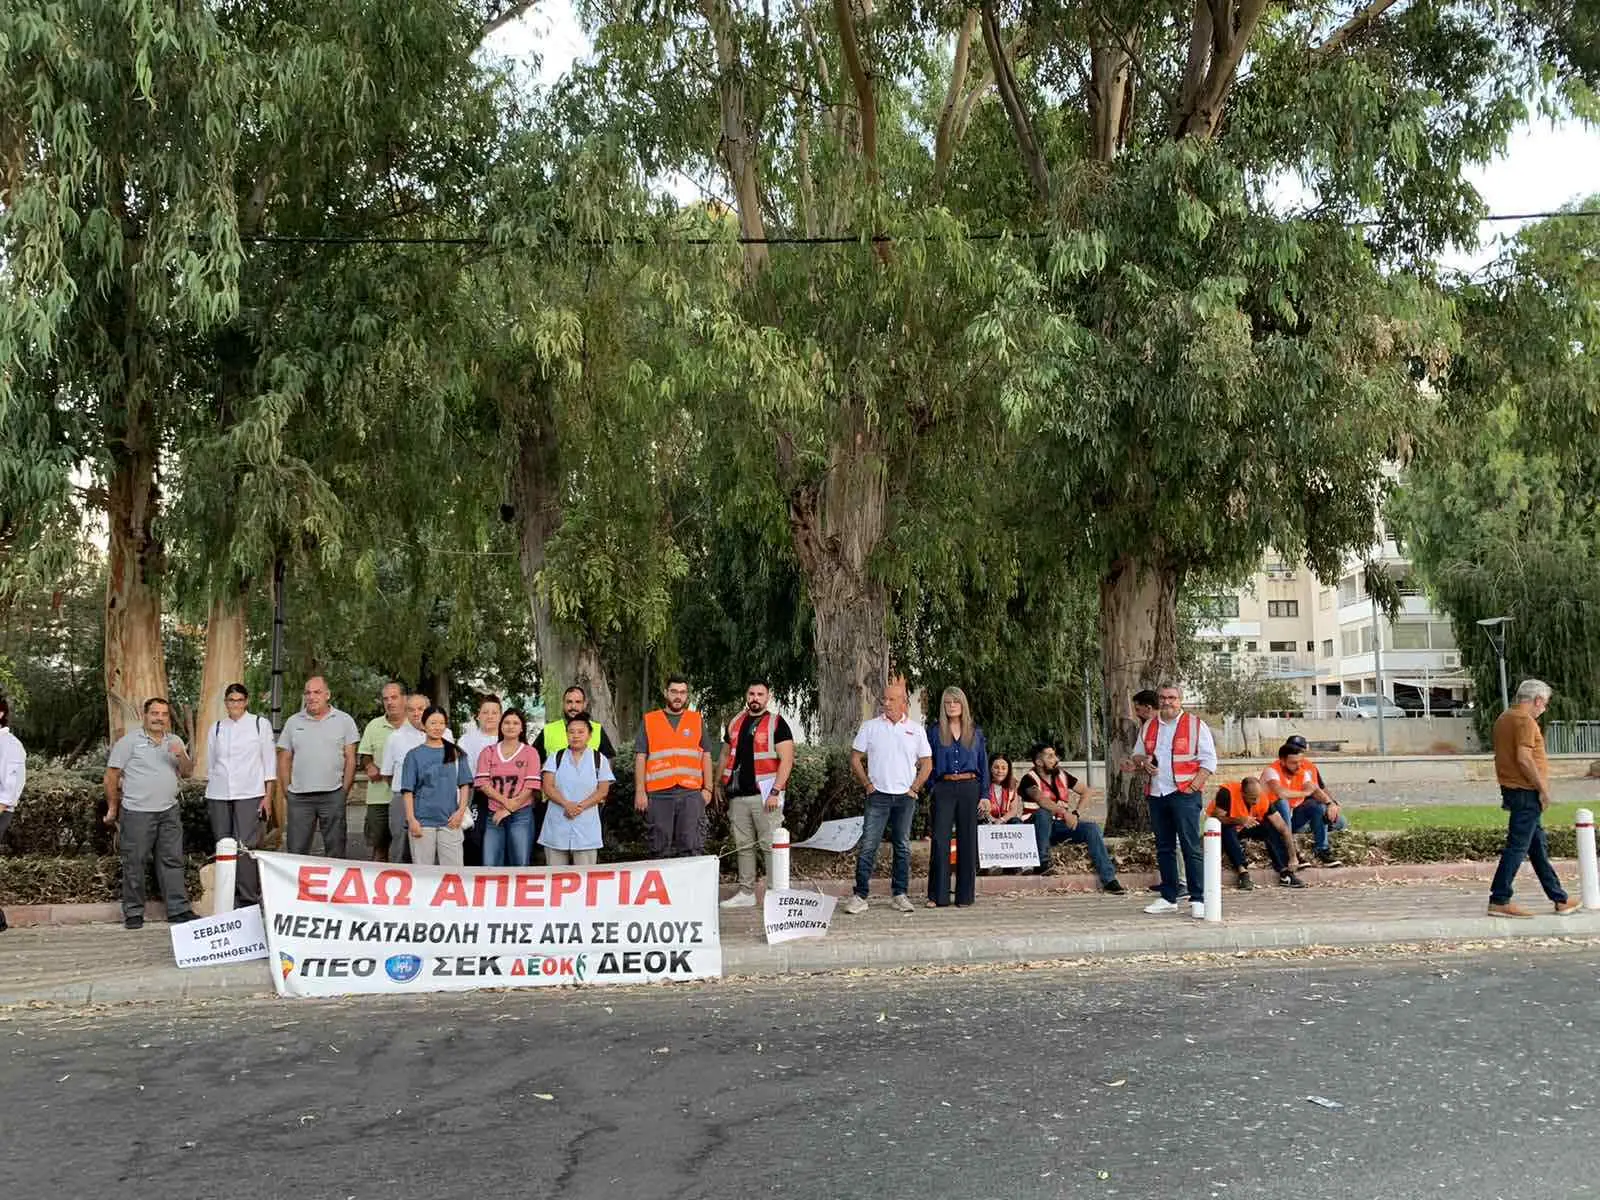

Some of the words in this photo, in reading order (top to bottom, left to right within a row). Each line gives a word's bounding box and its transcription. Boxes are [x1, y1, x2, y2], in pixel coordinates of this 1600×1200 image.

[297, 865, 413, 905] ΕΔΩ
[430, 869, 672, 907] ΑΠΕΡΓΙΑ
[778, 897, 819, 907] ΣΕΒΑΣΜΟ
[787, 908, 803, 917] ΣΤΑ
[193, 919, 242, 940] ΣΕΒΑΣΜΟ
[273, 913, 340, 940] ΜΕΣΗ
[348, 919, 478, 944] ΚΑΤΑΒΟΛΗ
[488, 922, 533, 944] ΤΗΣ
[540, 922, 583, 944] ΑΤΑ
[591, 922, 619, 944] ΣΕ
[626, 921, 703, 944] ΟΛΟΥΣ
[210, 937, 231, 950] ΣΤΑ
[300, 957, 377, 977] ΠΕΟ
[432, 955, 503, 976] ΣΕΚ
[511, 957, 574, 976] ΔΕΟΚ
[597, 950, 693, 974] ΔΕΟΚ
